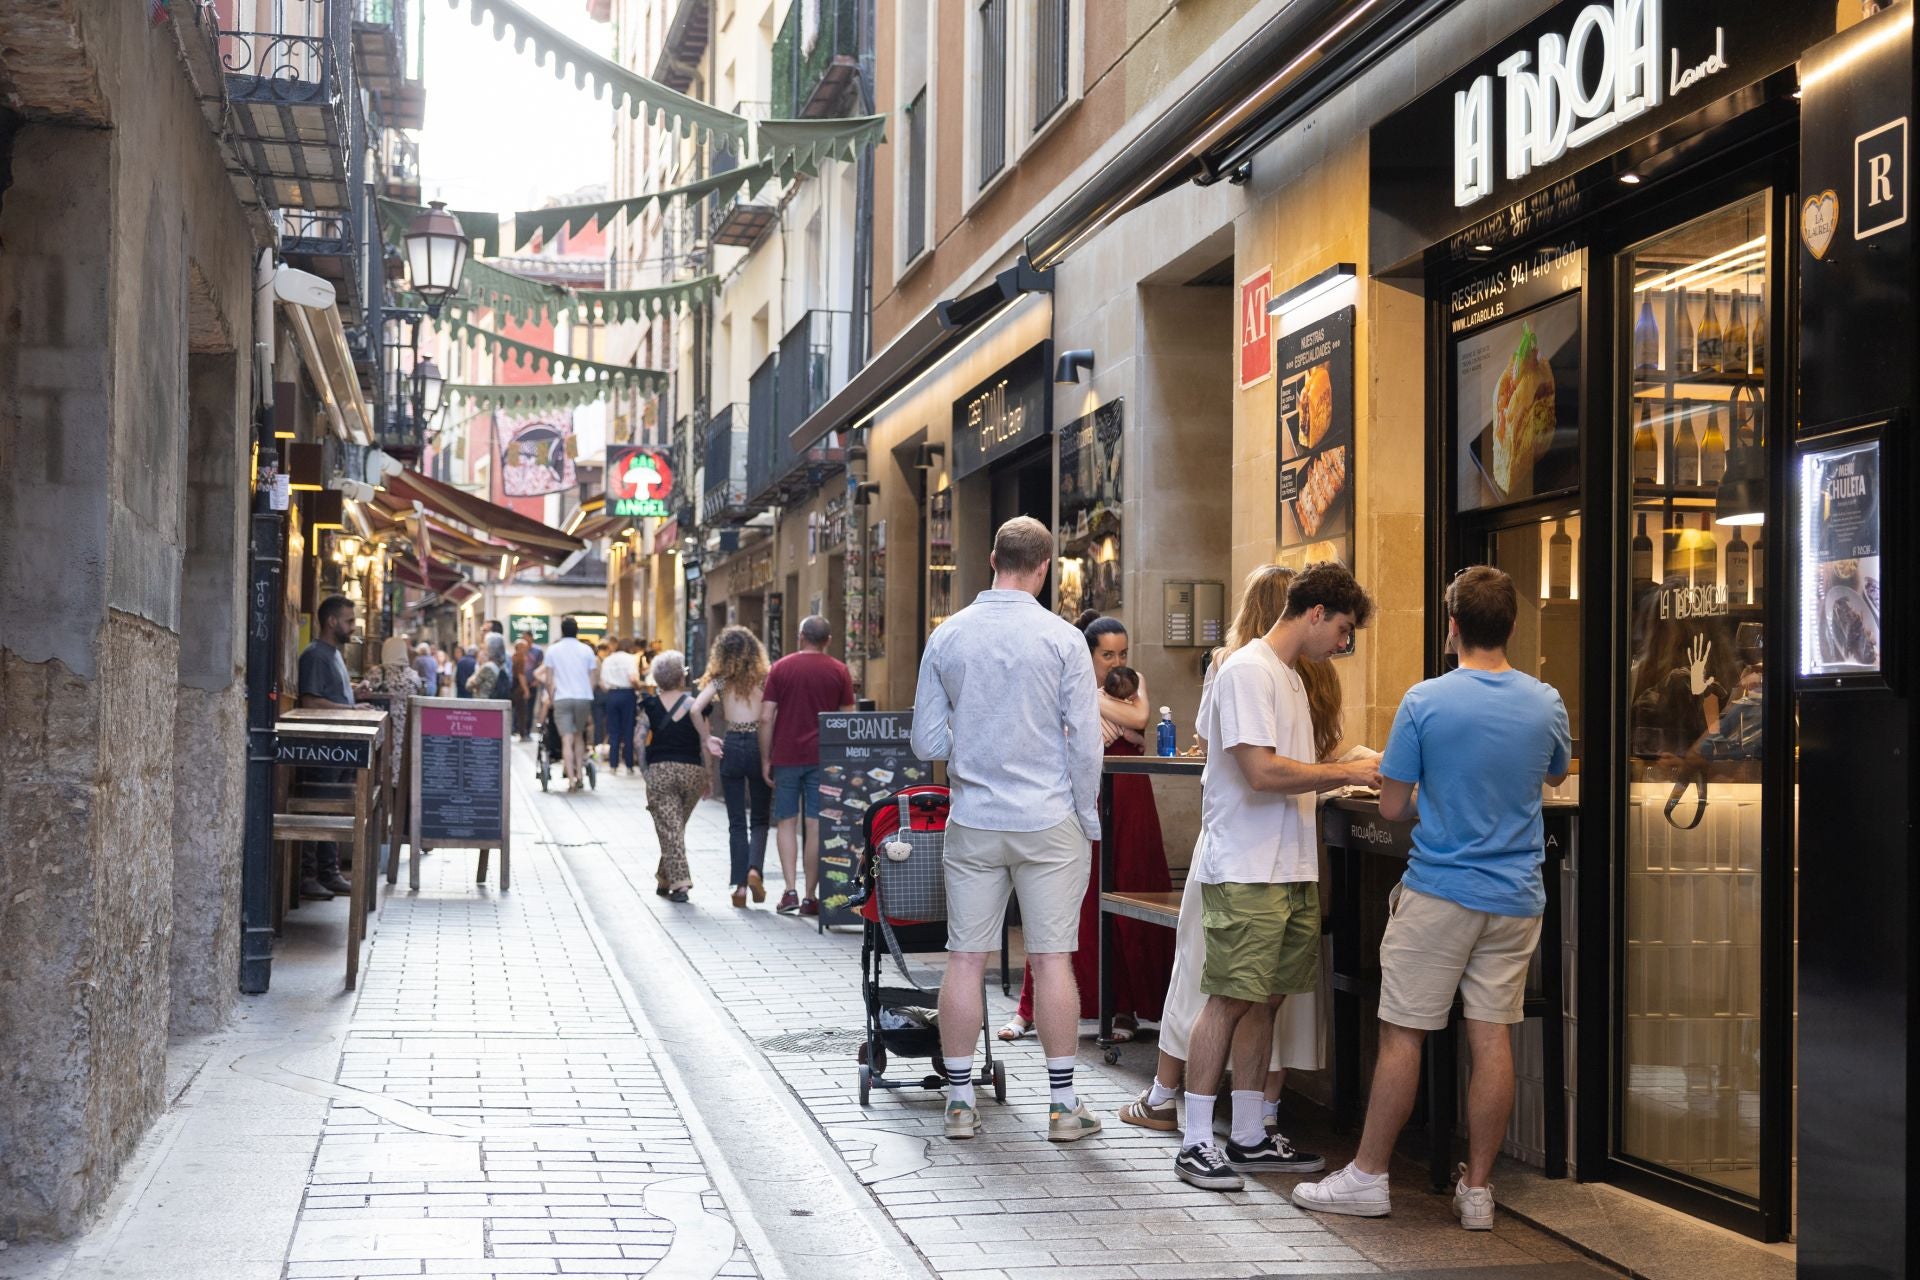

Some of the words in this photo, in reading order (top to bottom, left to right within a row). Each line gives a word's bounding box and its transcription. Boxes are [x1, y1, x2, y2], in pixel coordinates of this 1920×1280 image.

[1454, 75, 1493, 207] LA
[1497, 0, 1663, 180] TABOLA
[1670, 26, 1729, 97] Laurel
[1868, 152, 1893, 208] R
[1815, 213, 1824, 225] LA
[1451, 271, 1507, 314] RESERVAS:
[1510, 261, 1528, 288] 941
[1532, 253, 1550, 279] 418
[1555, 240, 1576, 270] 060
[1243, 281, 1270, 347] AT
[1451, 301, 1504, 333] WWW.LATABOLA.ES
[1300, 327, 1325, 350] NUESTRAS
[847, 717, 898, 740] GRANDE
[1351, 824, 1369, 839] RIOJA
[1376, 830, 1393, 845] VEGA
